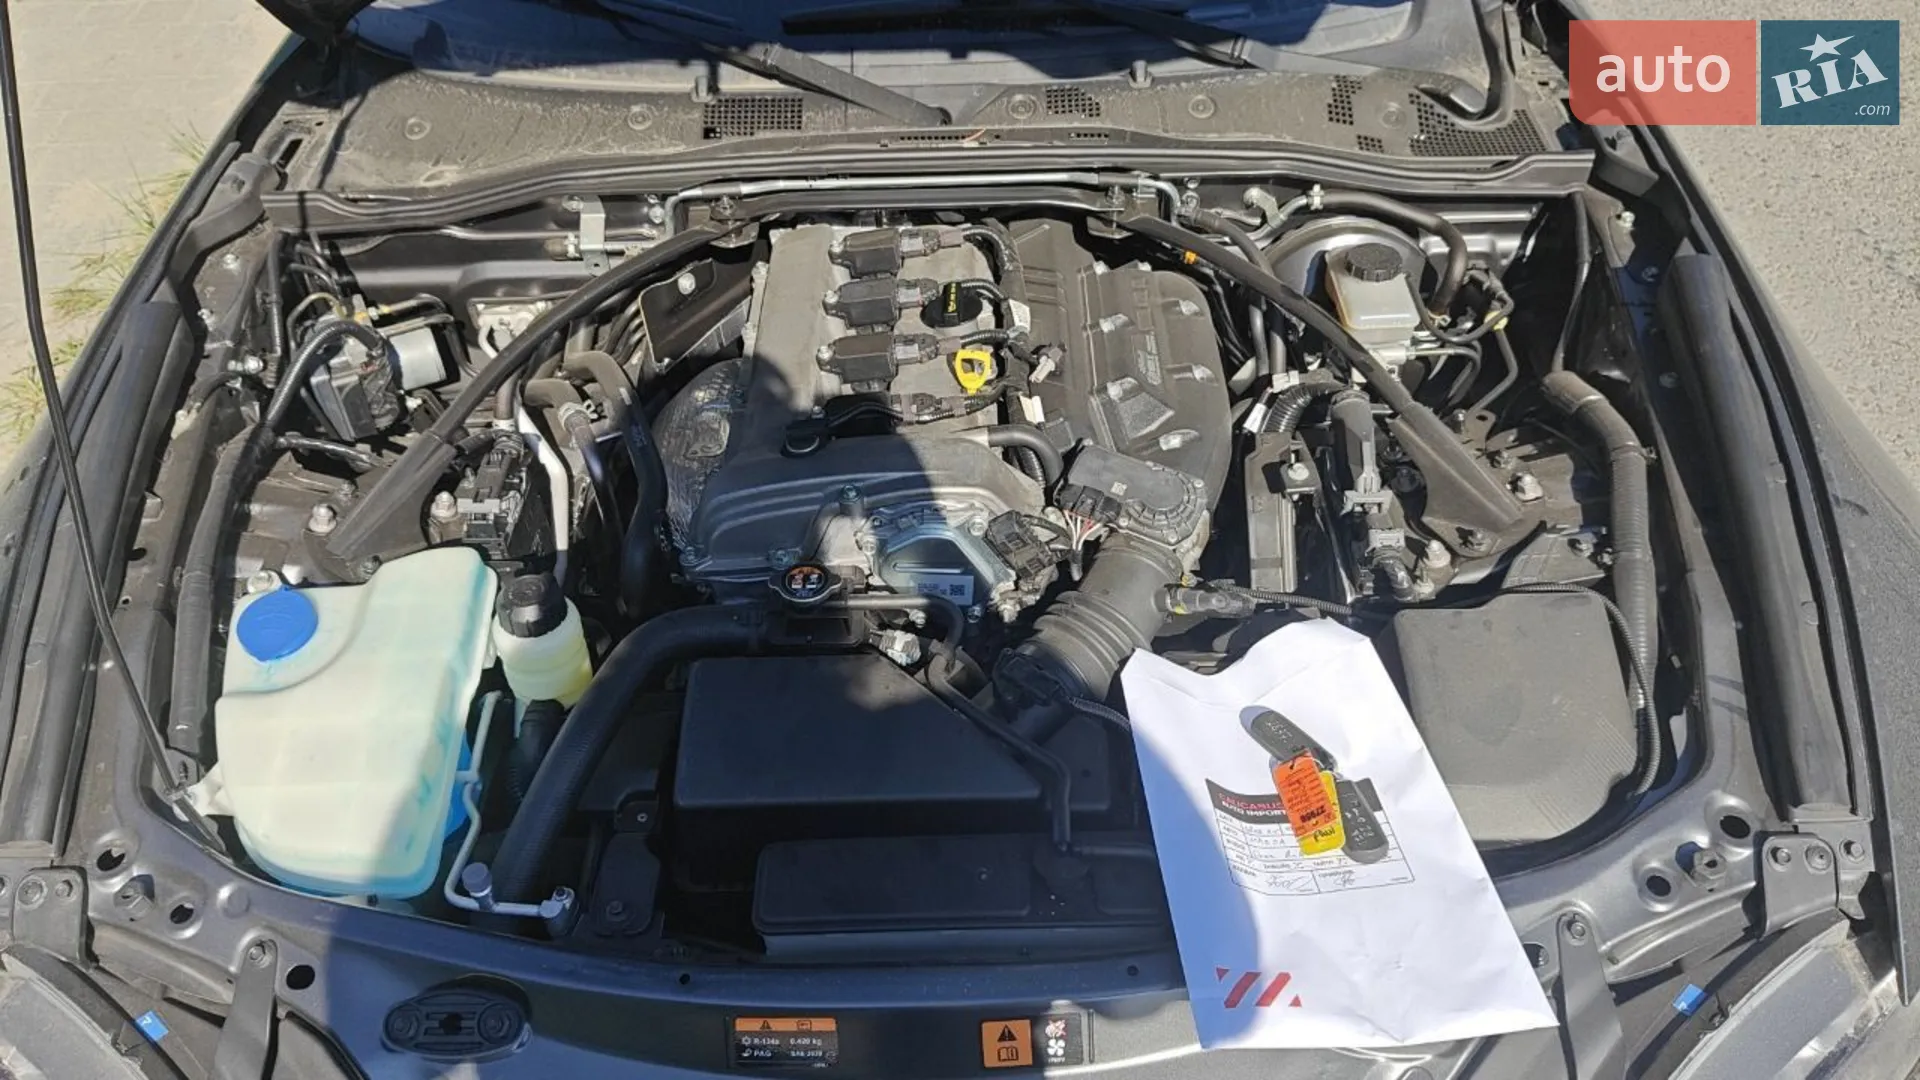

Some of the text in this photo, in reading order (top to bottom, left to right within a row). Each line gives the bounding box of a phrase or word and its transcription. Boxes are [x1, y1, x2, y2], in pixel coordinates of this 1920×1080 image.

[1222, 801, 1245, 815] AUTO
[753, 1037, 780, 1045] R-134a
[812, 1037, 822, 1046] kg
